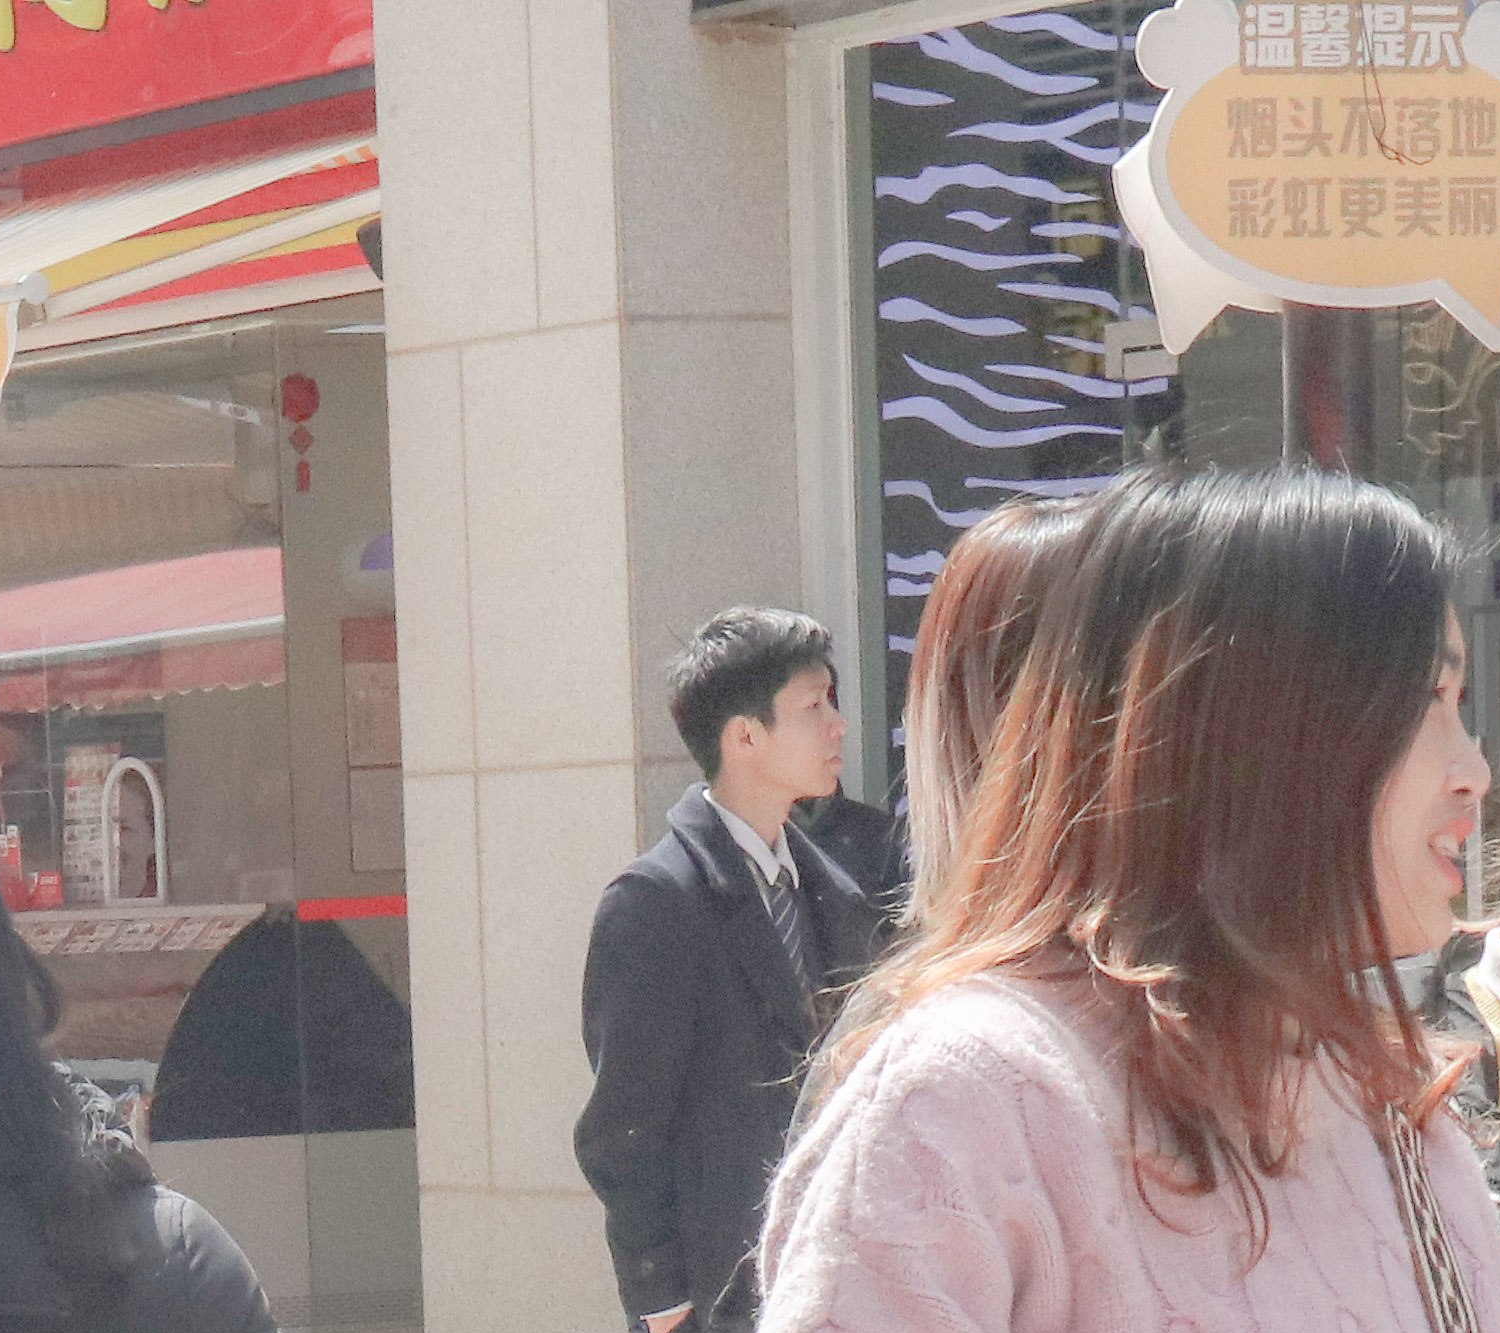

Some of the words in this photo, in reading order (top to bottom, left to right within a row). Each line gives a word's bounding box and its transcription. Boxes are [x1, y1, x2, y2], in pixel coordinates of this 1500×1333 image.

[1243, 2, 1461, 68] 温馨提示
[1227, 97, 1498, 158] 烟头不落地
[1228, 176, 1498, 238] 彩虹更美丽
